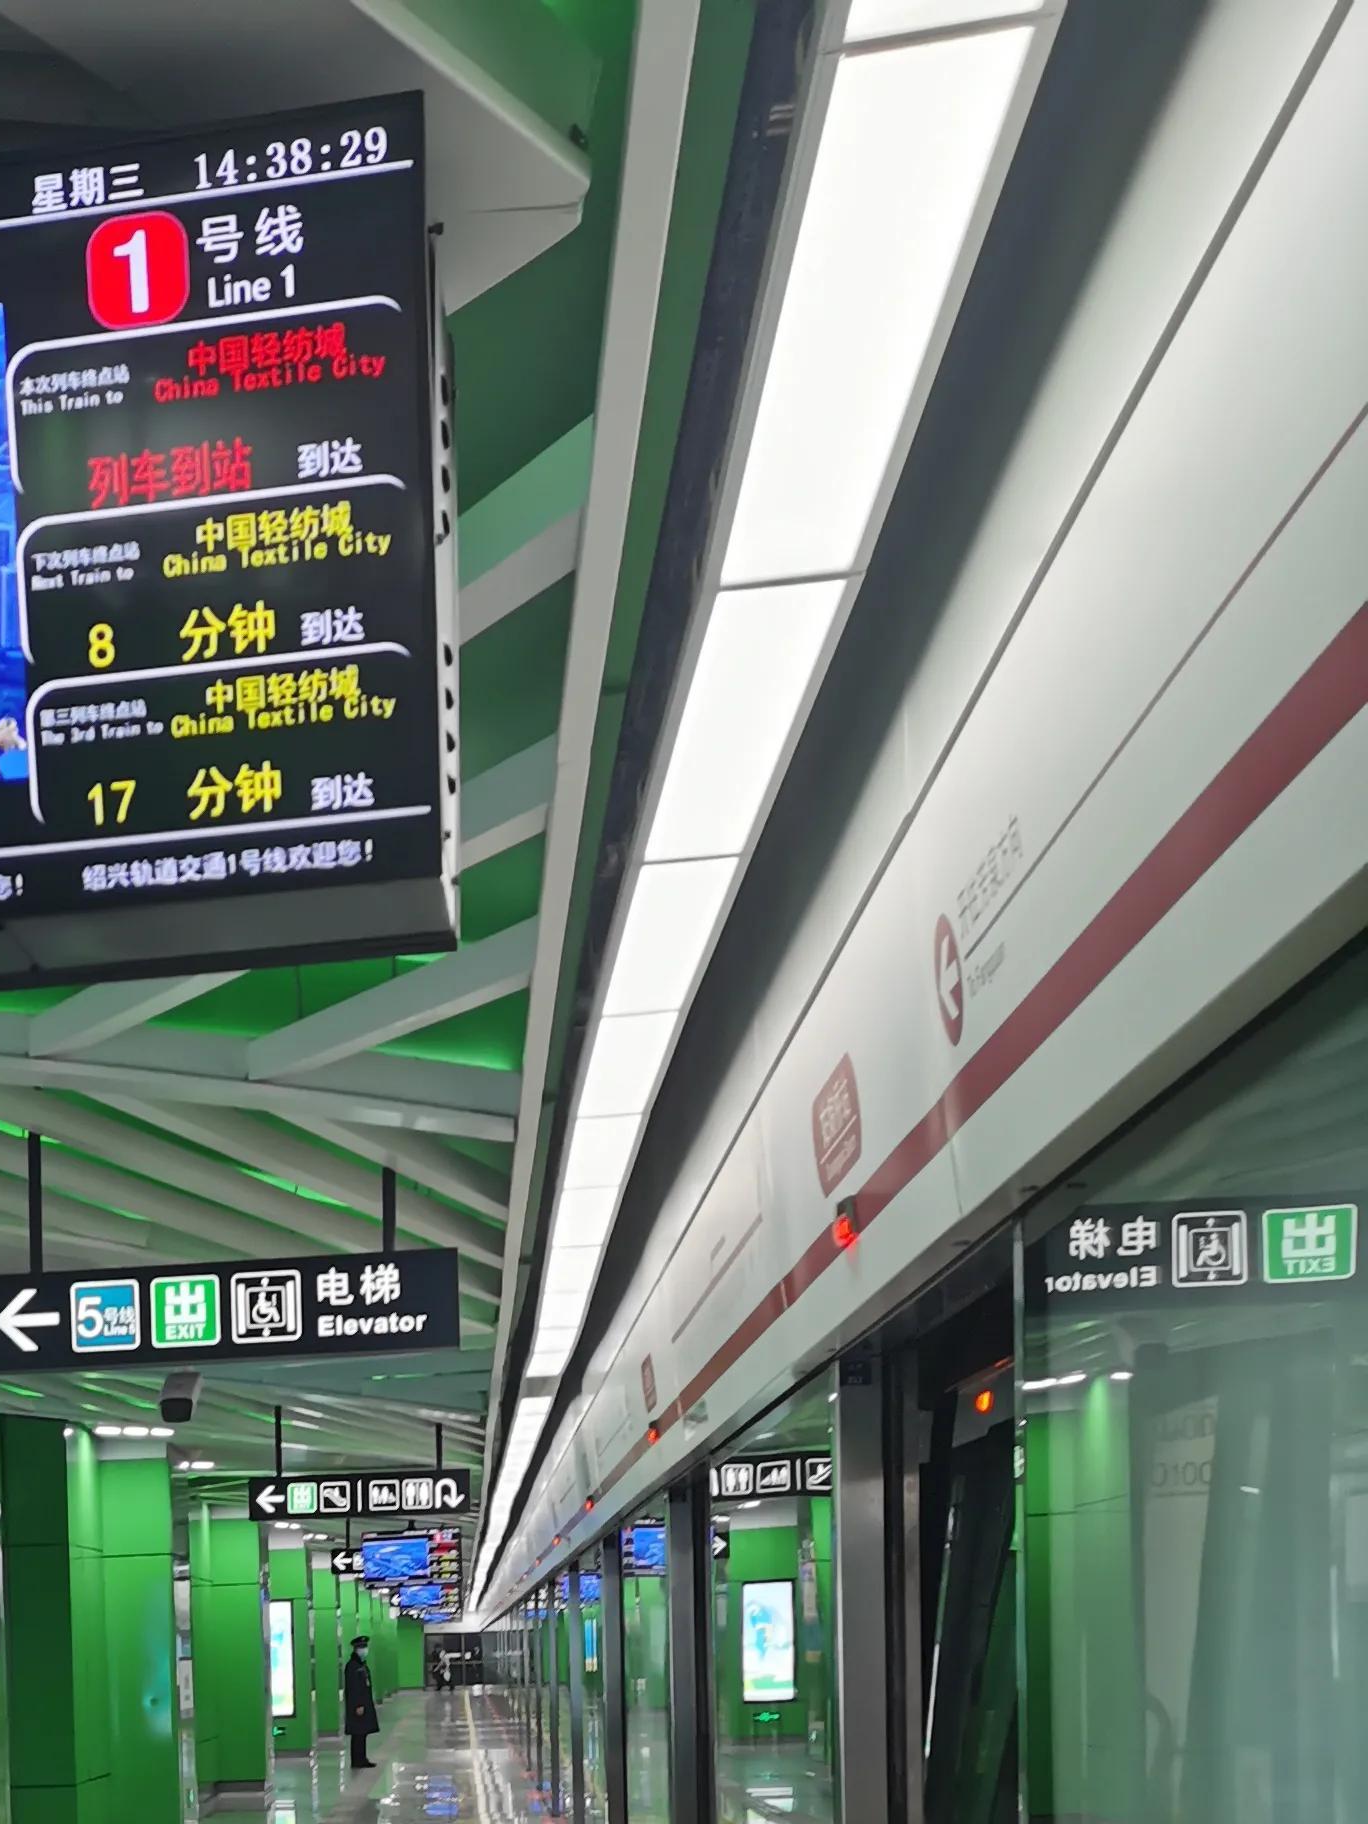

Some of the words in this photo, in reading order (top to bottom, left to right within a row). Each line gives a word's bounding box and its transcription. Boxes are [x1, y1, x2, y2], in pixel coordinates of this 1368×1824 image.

[32, 163, 144, 214] 星期三
[194, 126, 388, 190] 14:38:29
[113, 229, 150, 314] 1
[196, 204, 305, 264] 号线
[207, 275, 271, 309] Line
[280, 264, 295, 298] 1
[187, 322, 347, 377] 中国轻纺城
[19, 363, 130, 396] 本次列车终点站
[154, 376, 218, 404] China
[232, 362, 322, 393] Textile
[332, 353, 386, 379] City
[20, 397, 54, 416] This
[59, 391, 101, 412] Train
[105, 390, 124, 405] to
[88, 436, 252, 510] 列车到站
[297, 437, 364, 479] 到达
[196, 500, 355, 554] 中国轻纺城
[30, 540, 141, 573] 下次列车终点站
[70, 567, 111, 586] Train
[116, 566, 135, 581] to
[162, 552, 228, 579] China
[240, 537, 328, 569] Textile
[338, 530, 392, 557] City
[88, 622, 116, 669] 8
[179, 600, 277, 663] 分钟
[299, 606, 365, 647] 到达
[205, 664, 360, 714] 中国轻纺城
[100, 723, 141, 740] Train
[145, 720, 164, 736] to
[170, 711, 234, 739] China
[247, 699, 334, 731] Textile
[343, 694, 397, 720] City
[87, 779, 137, 826] 17
[186, 760, 283, 821] 分钟
[310, 771, 376, 811] 到达
[164, 1281, 207, 1324] 出
[316, 1262, 401, 1306] 电梯
[77, 1296, 104, 1338] 5
[164, 1322, 206, 1341] EXIT
[317, 1311, 428, 1338] Elevator
